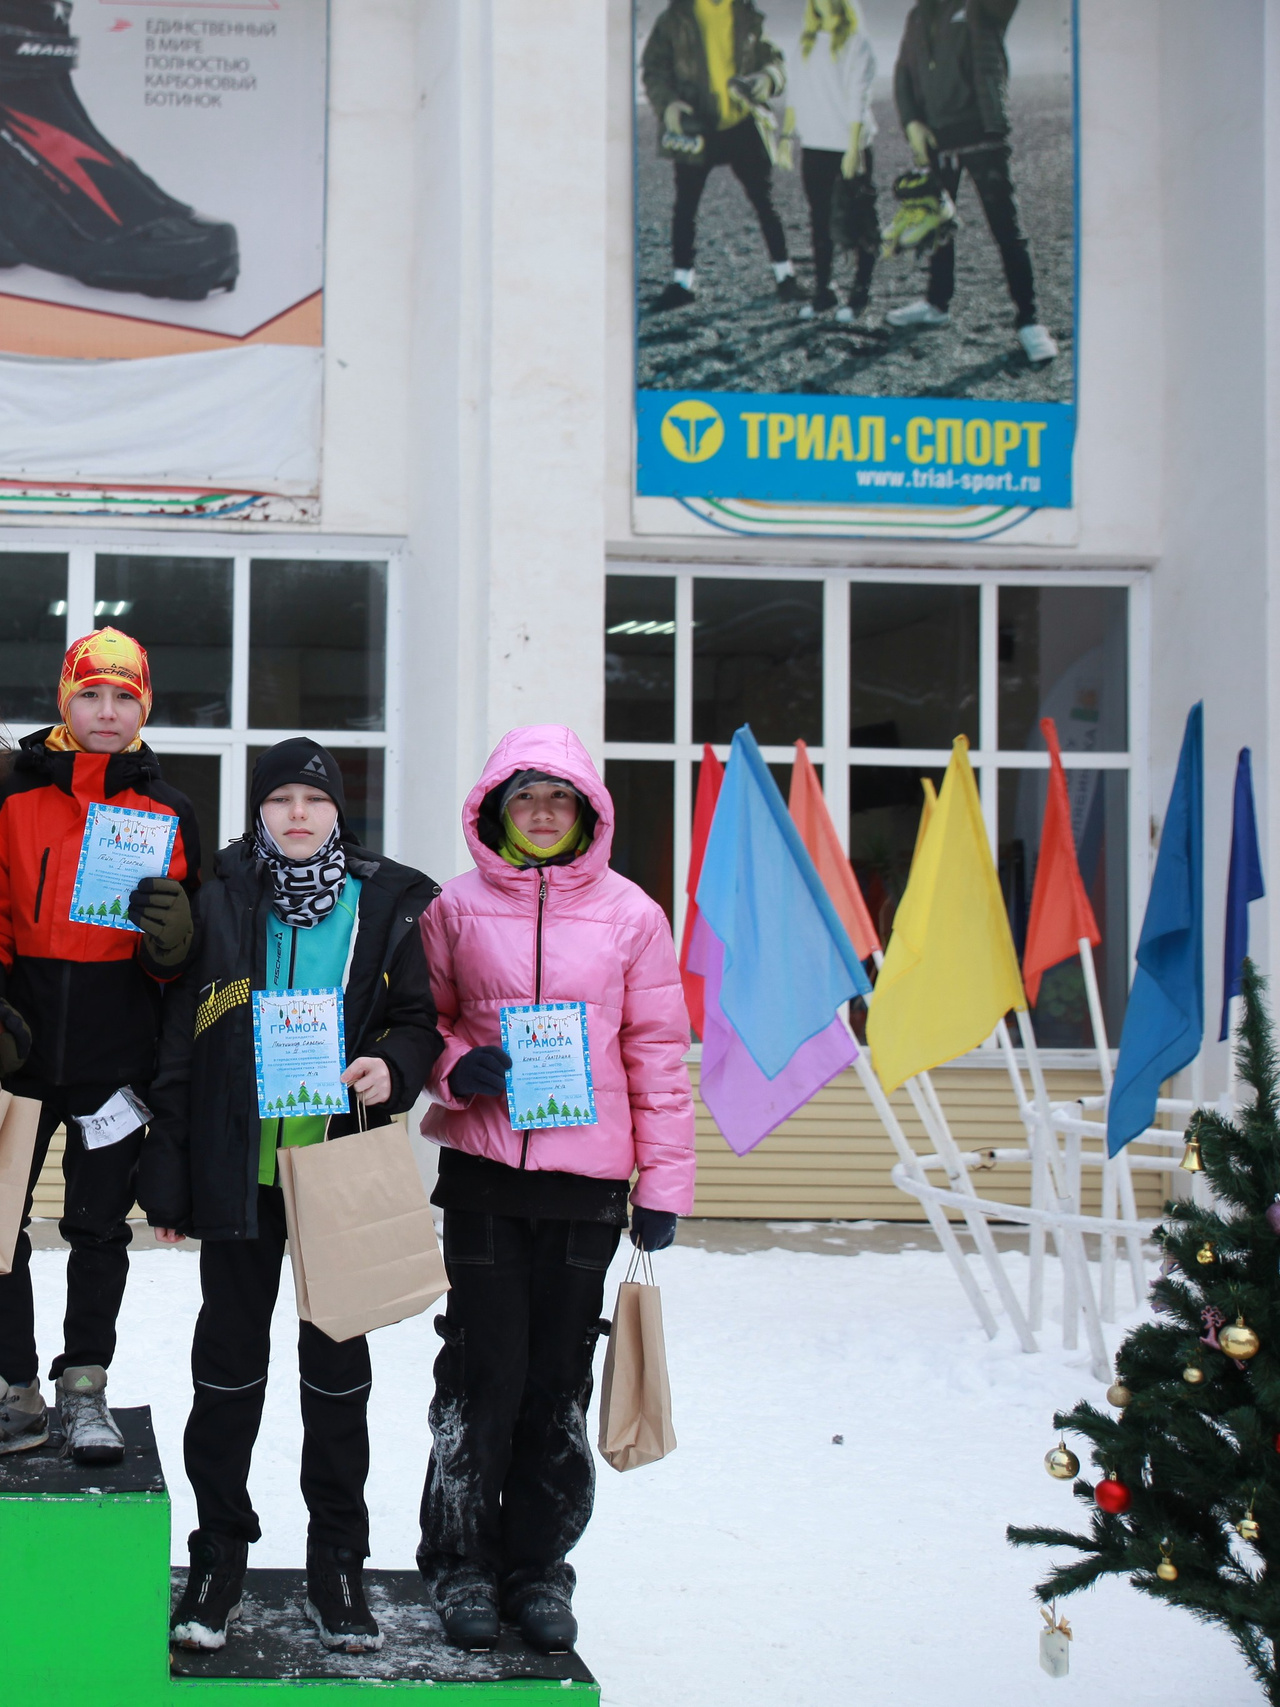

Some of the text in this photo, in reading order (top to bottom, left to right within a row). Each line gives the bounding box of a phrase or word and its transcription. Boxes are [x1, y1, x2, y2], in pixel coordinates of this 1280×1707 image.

[146, 18, 276, 37] ЕДИНСТВЕННЫЙ
[145, 38, 203, 54] В МИРЕ
[145, 55, 250, 72] ПОЛНОСТЬЮ
[144, 74, 256, 90] КАРБОНОВЫЙ
[144, 91, 222, 108] БОТИНОК
[856, 468, 1041, 494] www.trial-sport.ru
[85, 667, 135, 680] FISCHER
[99, 838, 155, 855] ГРАМОТА
[274, 942, 282, 986] FISCHER
[270, 1022, 327, 1034] ГРАМОТА
[518, 1036, 572, 1049] ГРАМОТА
